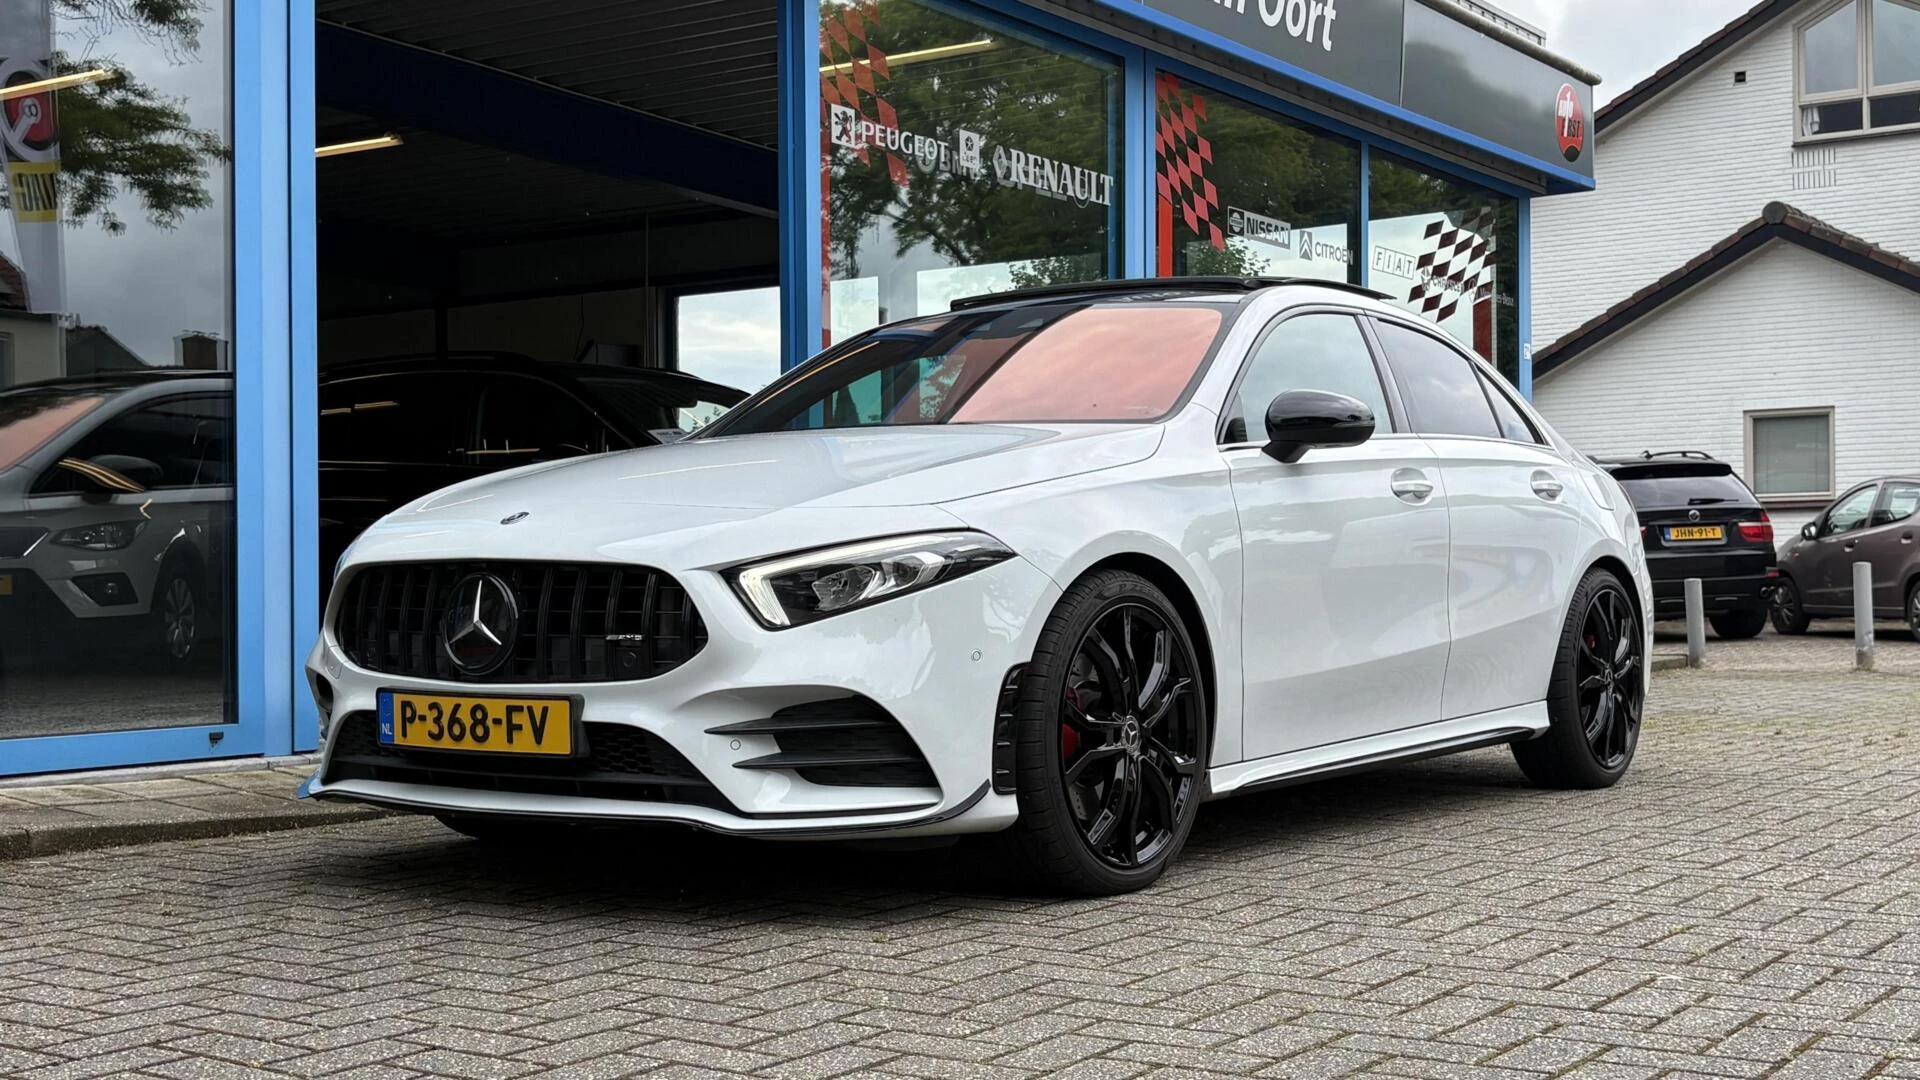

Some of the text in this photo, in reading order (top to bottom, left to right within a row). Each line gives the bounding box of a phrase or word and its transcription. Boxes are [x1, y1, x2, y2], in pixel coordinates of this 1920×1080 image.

[861, 120, 949, 162] PEUGEOT
[1009, 148, 1114, 206] RENAULT
[1246, 217, 1289, 245] NISSAN
[1375, 251, 1414, 276] FIAT
[1675, 527, 1718, 538] JHN-91-T
[381, 722, 393, 735] NL
[400, 700, 549, 746] P-368-FV
